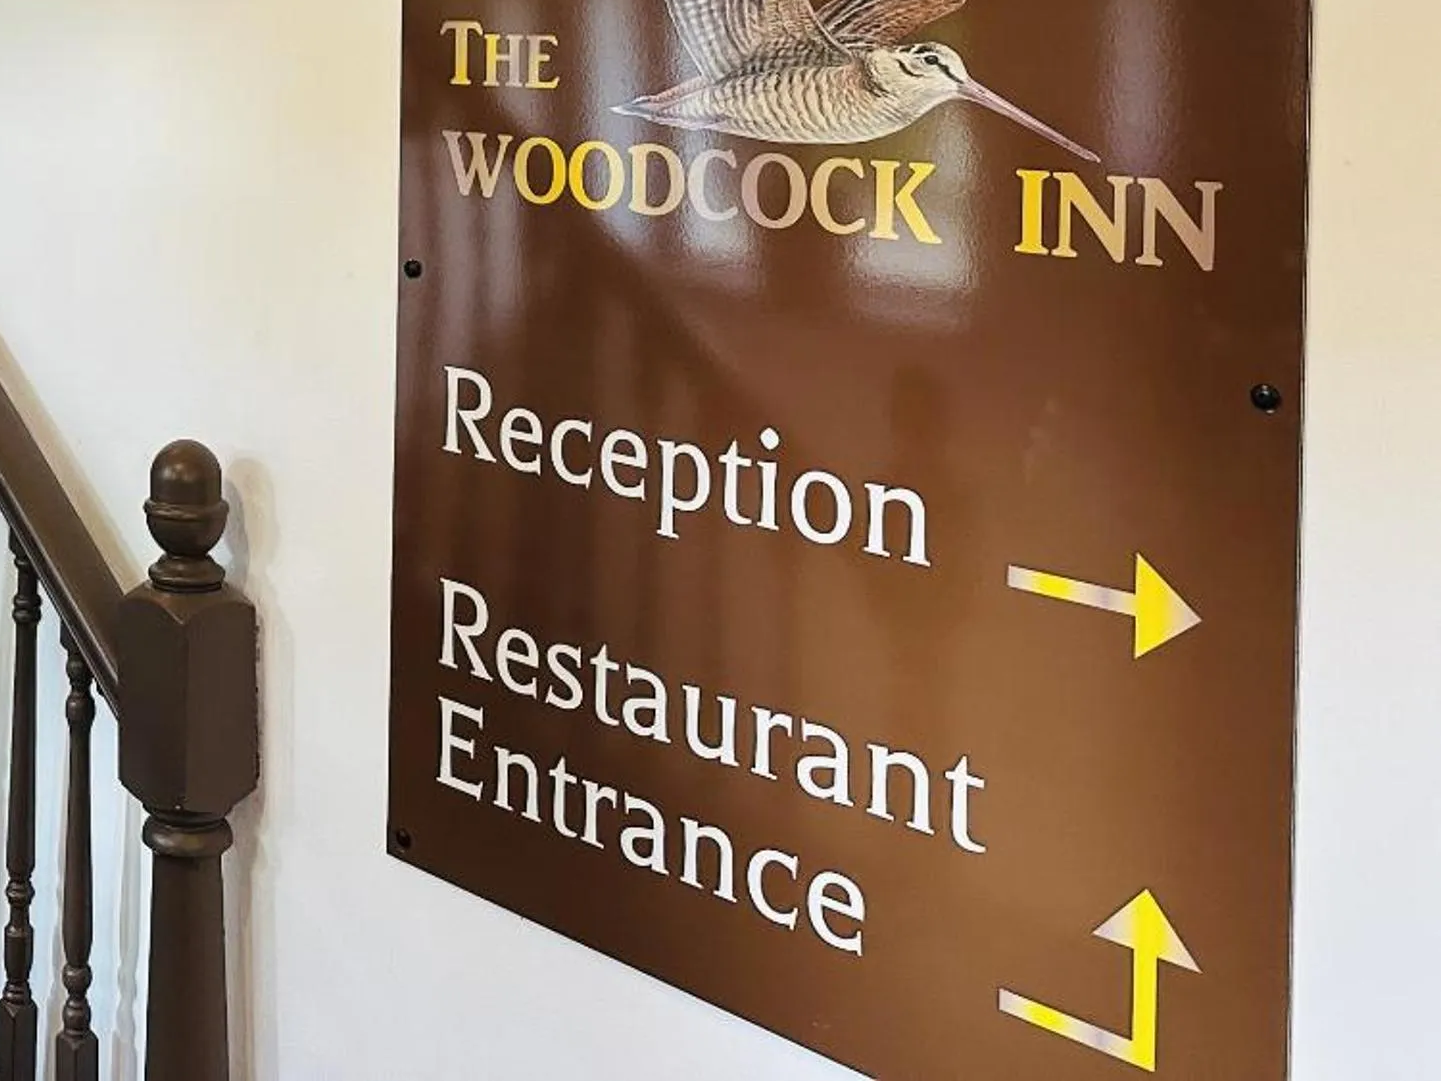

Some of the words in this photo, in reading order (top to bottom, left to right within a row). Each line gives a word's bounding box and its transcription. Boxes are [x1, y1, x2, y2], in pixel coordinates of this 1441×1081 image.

[440, 20, 560, 91] THE
[441, 129, 942, 245] WOODCOCK
[1014, 168, 1224, 272] INN
[441, 365, 931, 567] Reception
[438, 577, 987, 853] Restaurant
[435, 696, 867, 957] Entrance
